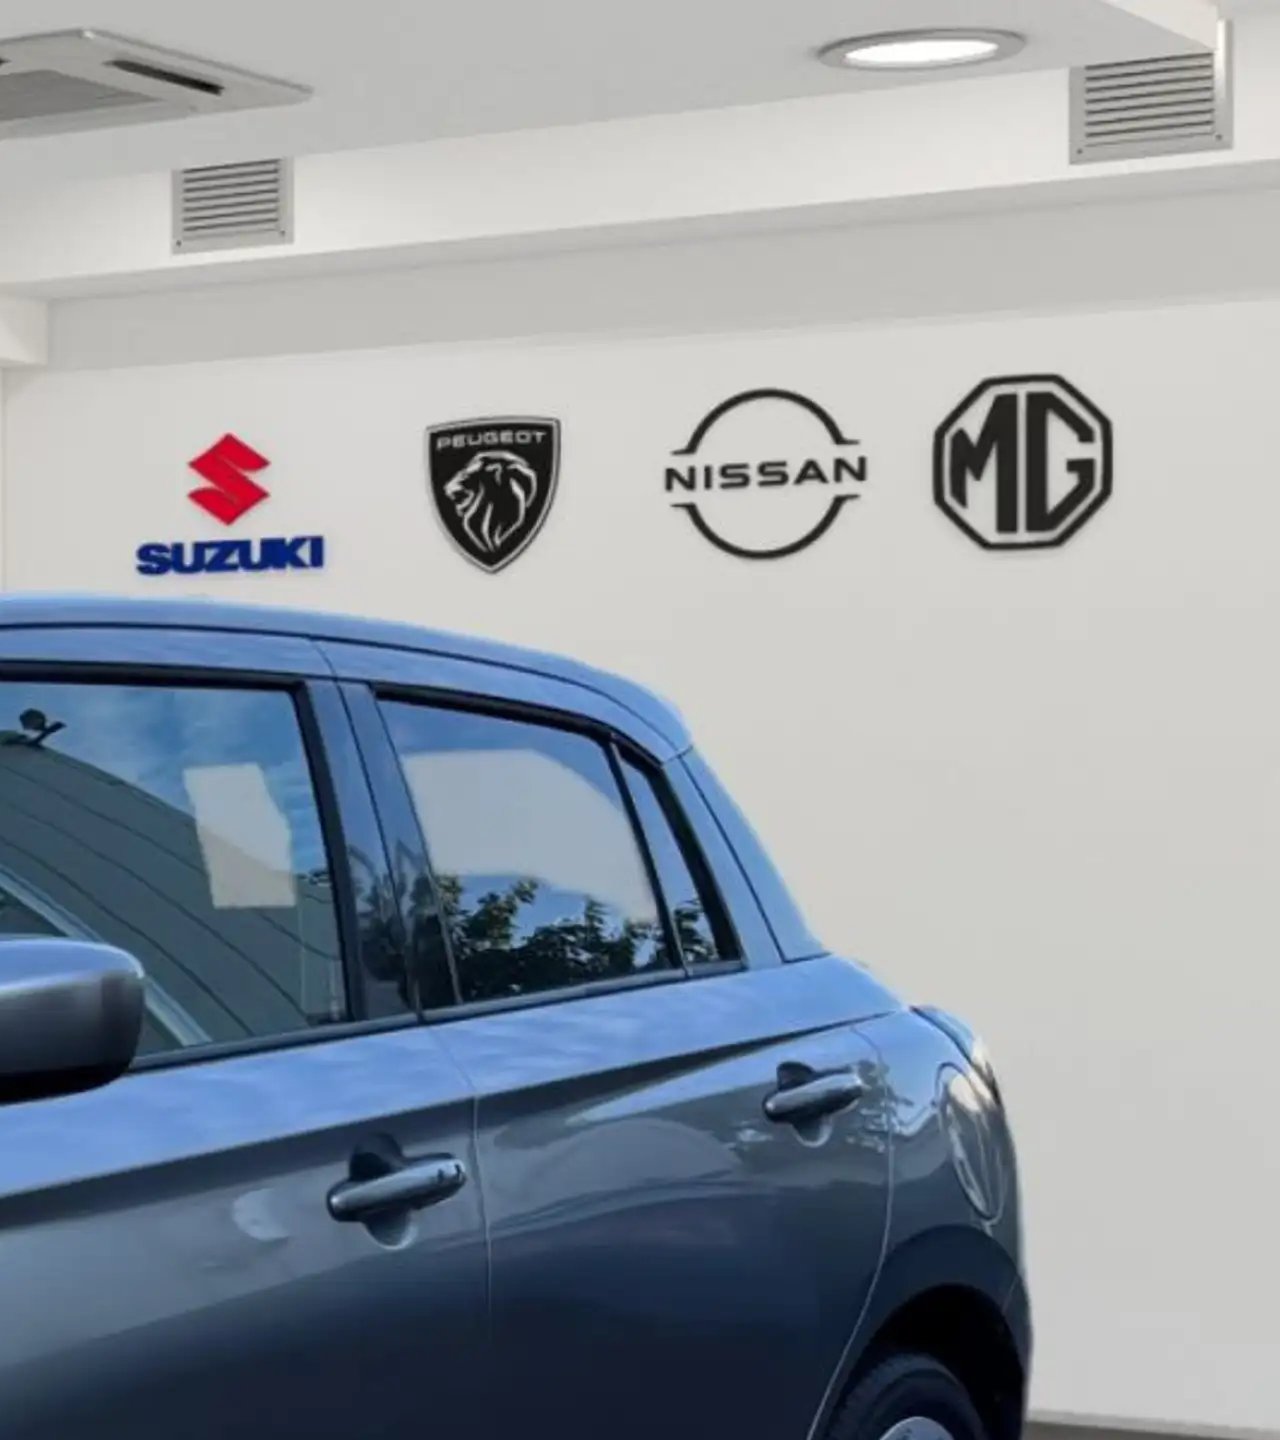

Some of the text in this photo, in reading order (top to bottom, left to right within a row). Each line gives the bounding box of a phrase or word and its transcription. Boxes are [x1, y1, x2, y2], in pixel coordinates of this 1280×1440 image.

[436, 428, 547, 449] PEUGEOT
[664, 455, 867, 493] NISSAN
[948, 391, 1096, 534] MG
[135, 535, 324, 576] SUZUKI
